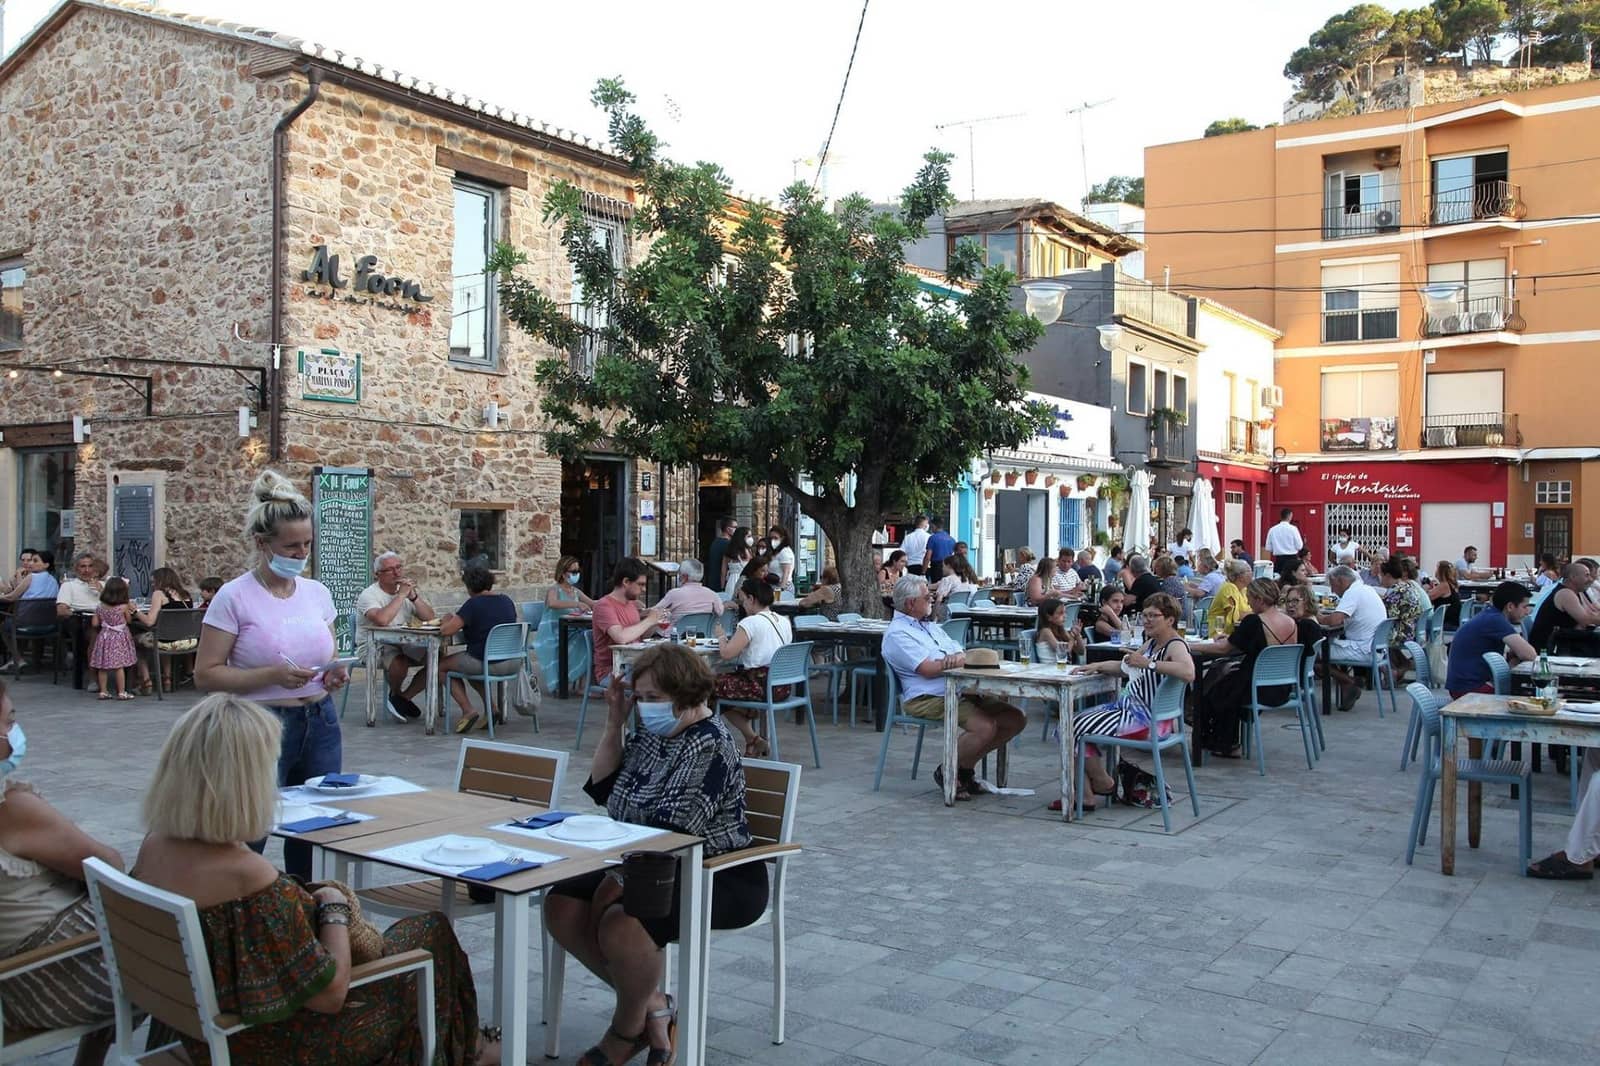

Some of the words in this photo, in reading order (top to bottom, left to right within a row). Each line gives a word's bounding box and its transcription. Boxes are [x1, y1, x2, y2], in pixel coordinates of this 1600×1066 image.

[302, 245, 348, 289] Al
[353, 255, 434, 302] Forn
[318, 366, 344, 377] PLAÇA
[1332, 472, 1356, 480] rincón
[1358, 472, 1368, 480] de
[1335, 480, 1412, 495] Montava
